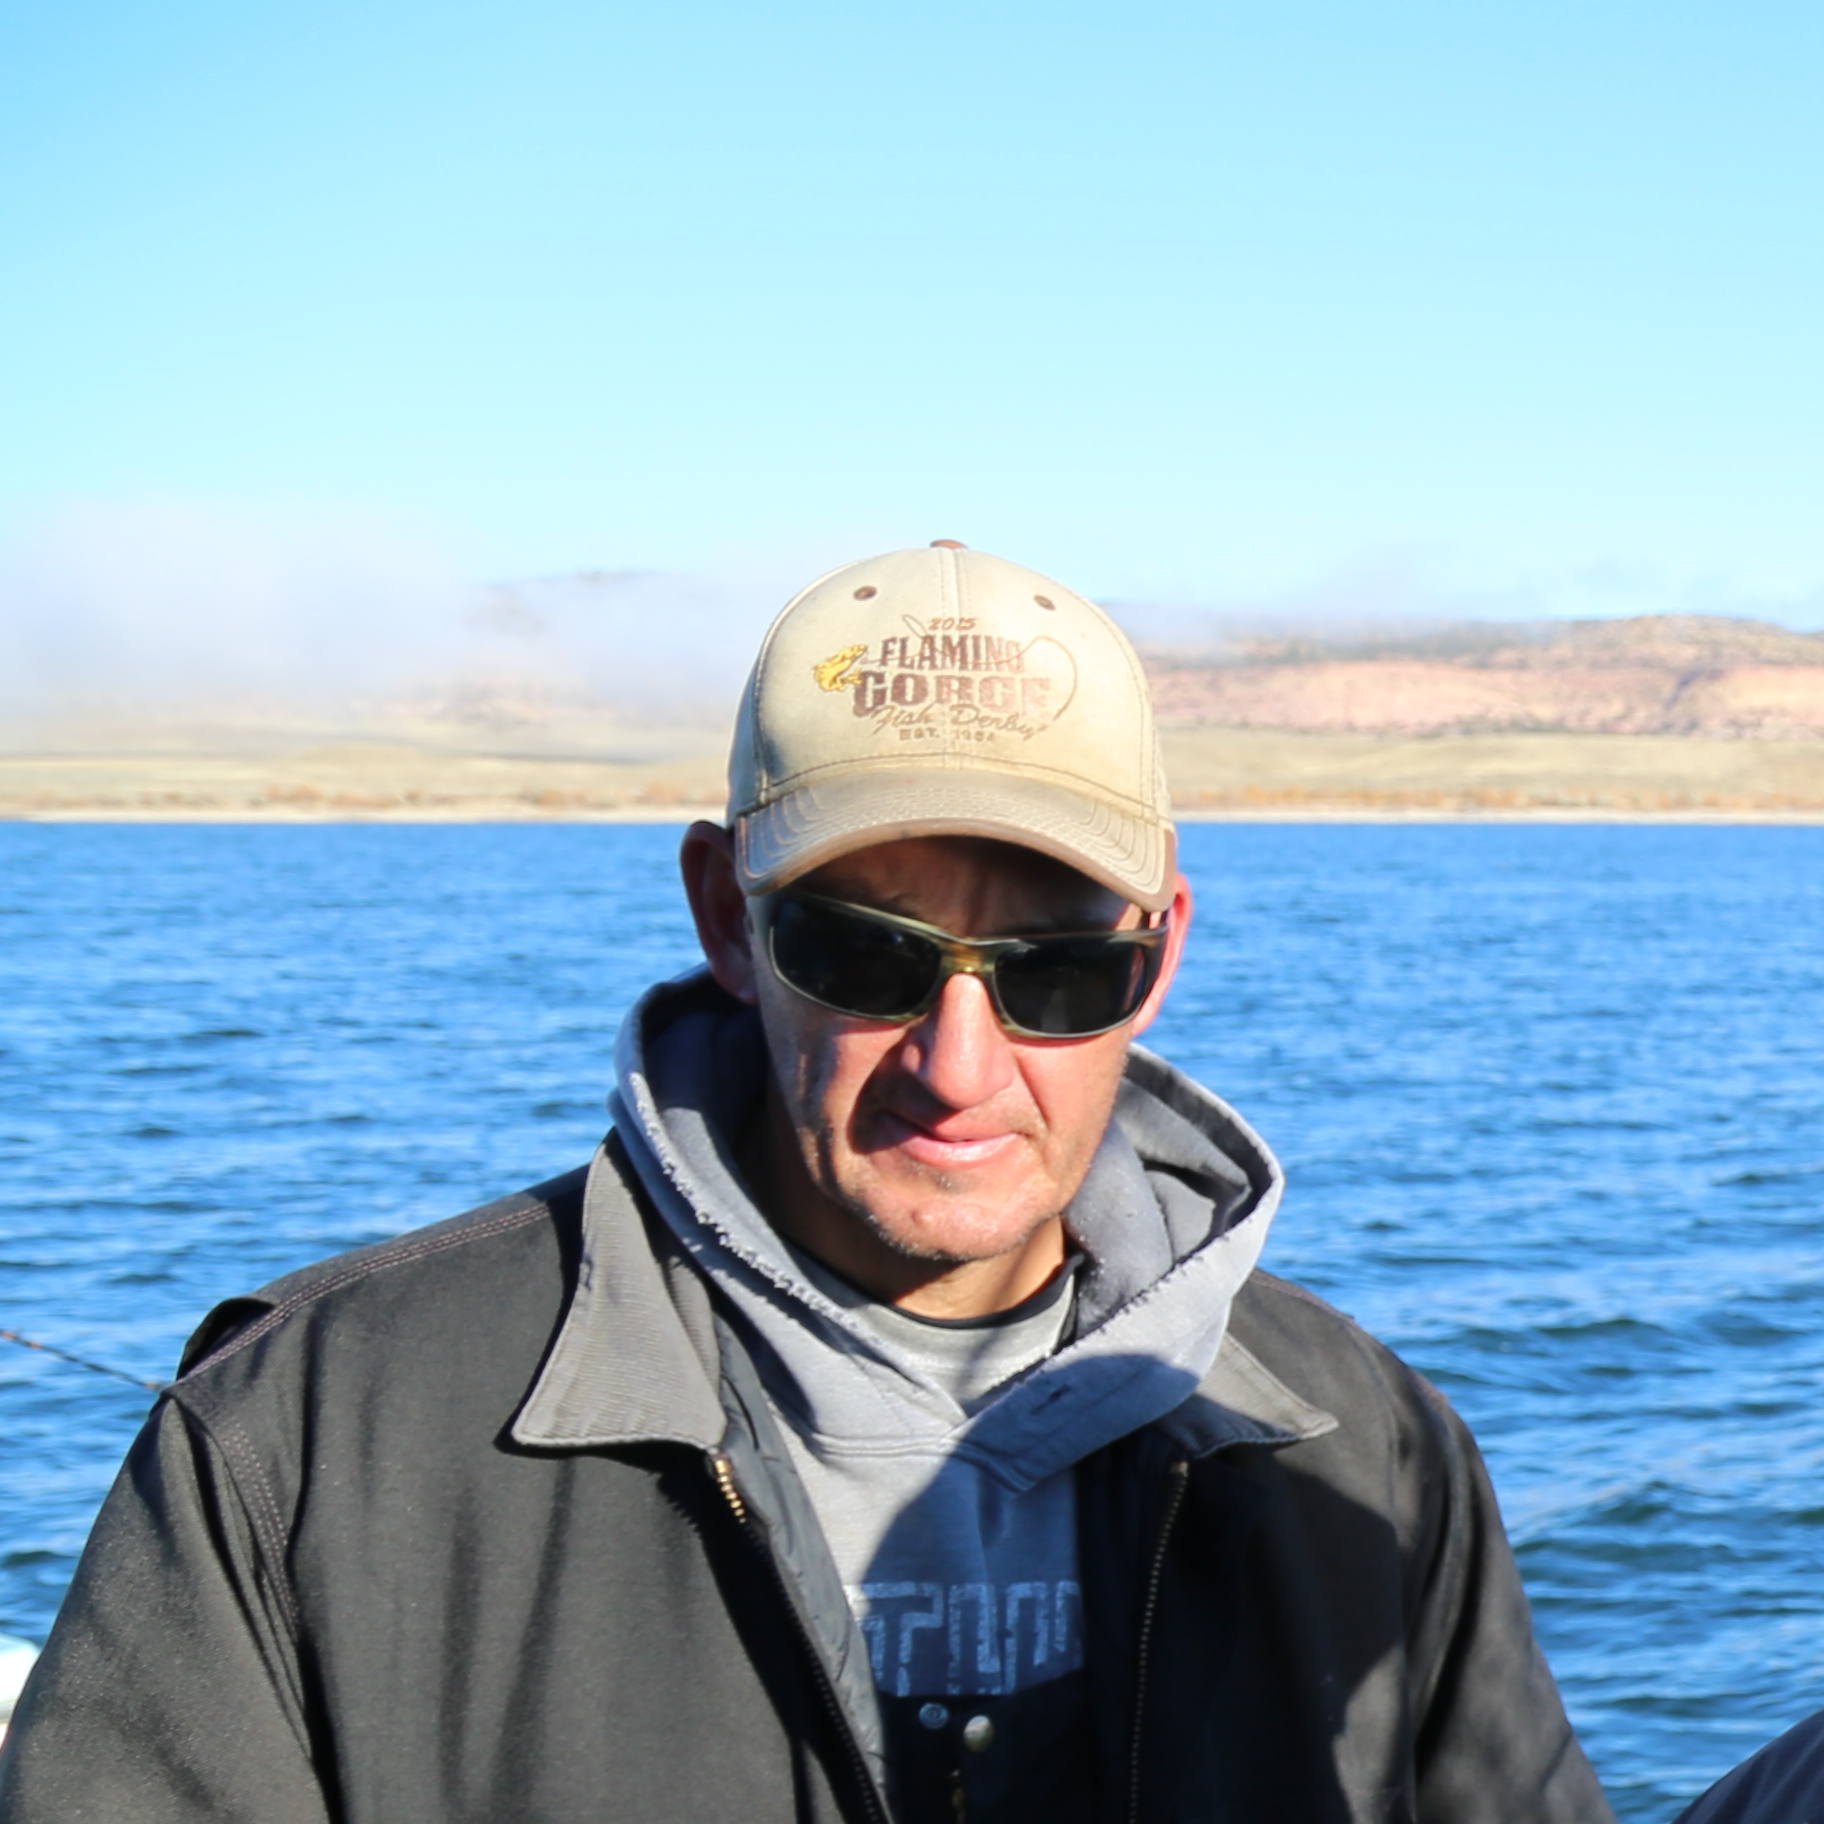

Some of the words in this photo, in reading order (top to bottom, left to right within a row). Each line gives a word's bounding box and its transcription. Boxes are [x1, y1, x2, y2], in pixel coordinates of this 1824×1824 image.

[928, 616, 978, 632] 2015
[878, 633, 1026, 675] FLAMING
[852, 669, 1052, 722] GORGE
[870, 700, 938, 736] Fish
[948, 702, 1049, 742] Derby
